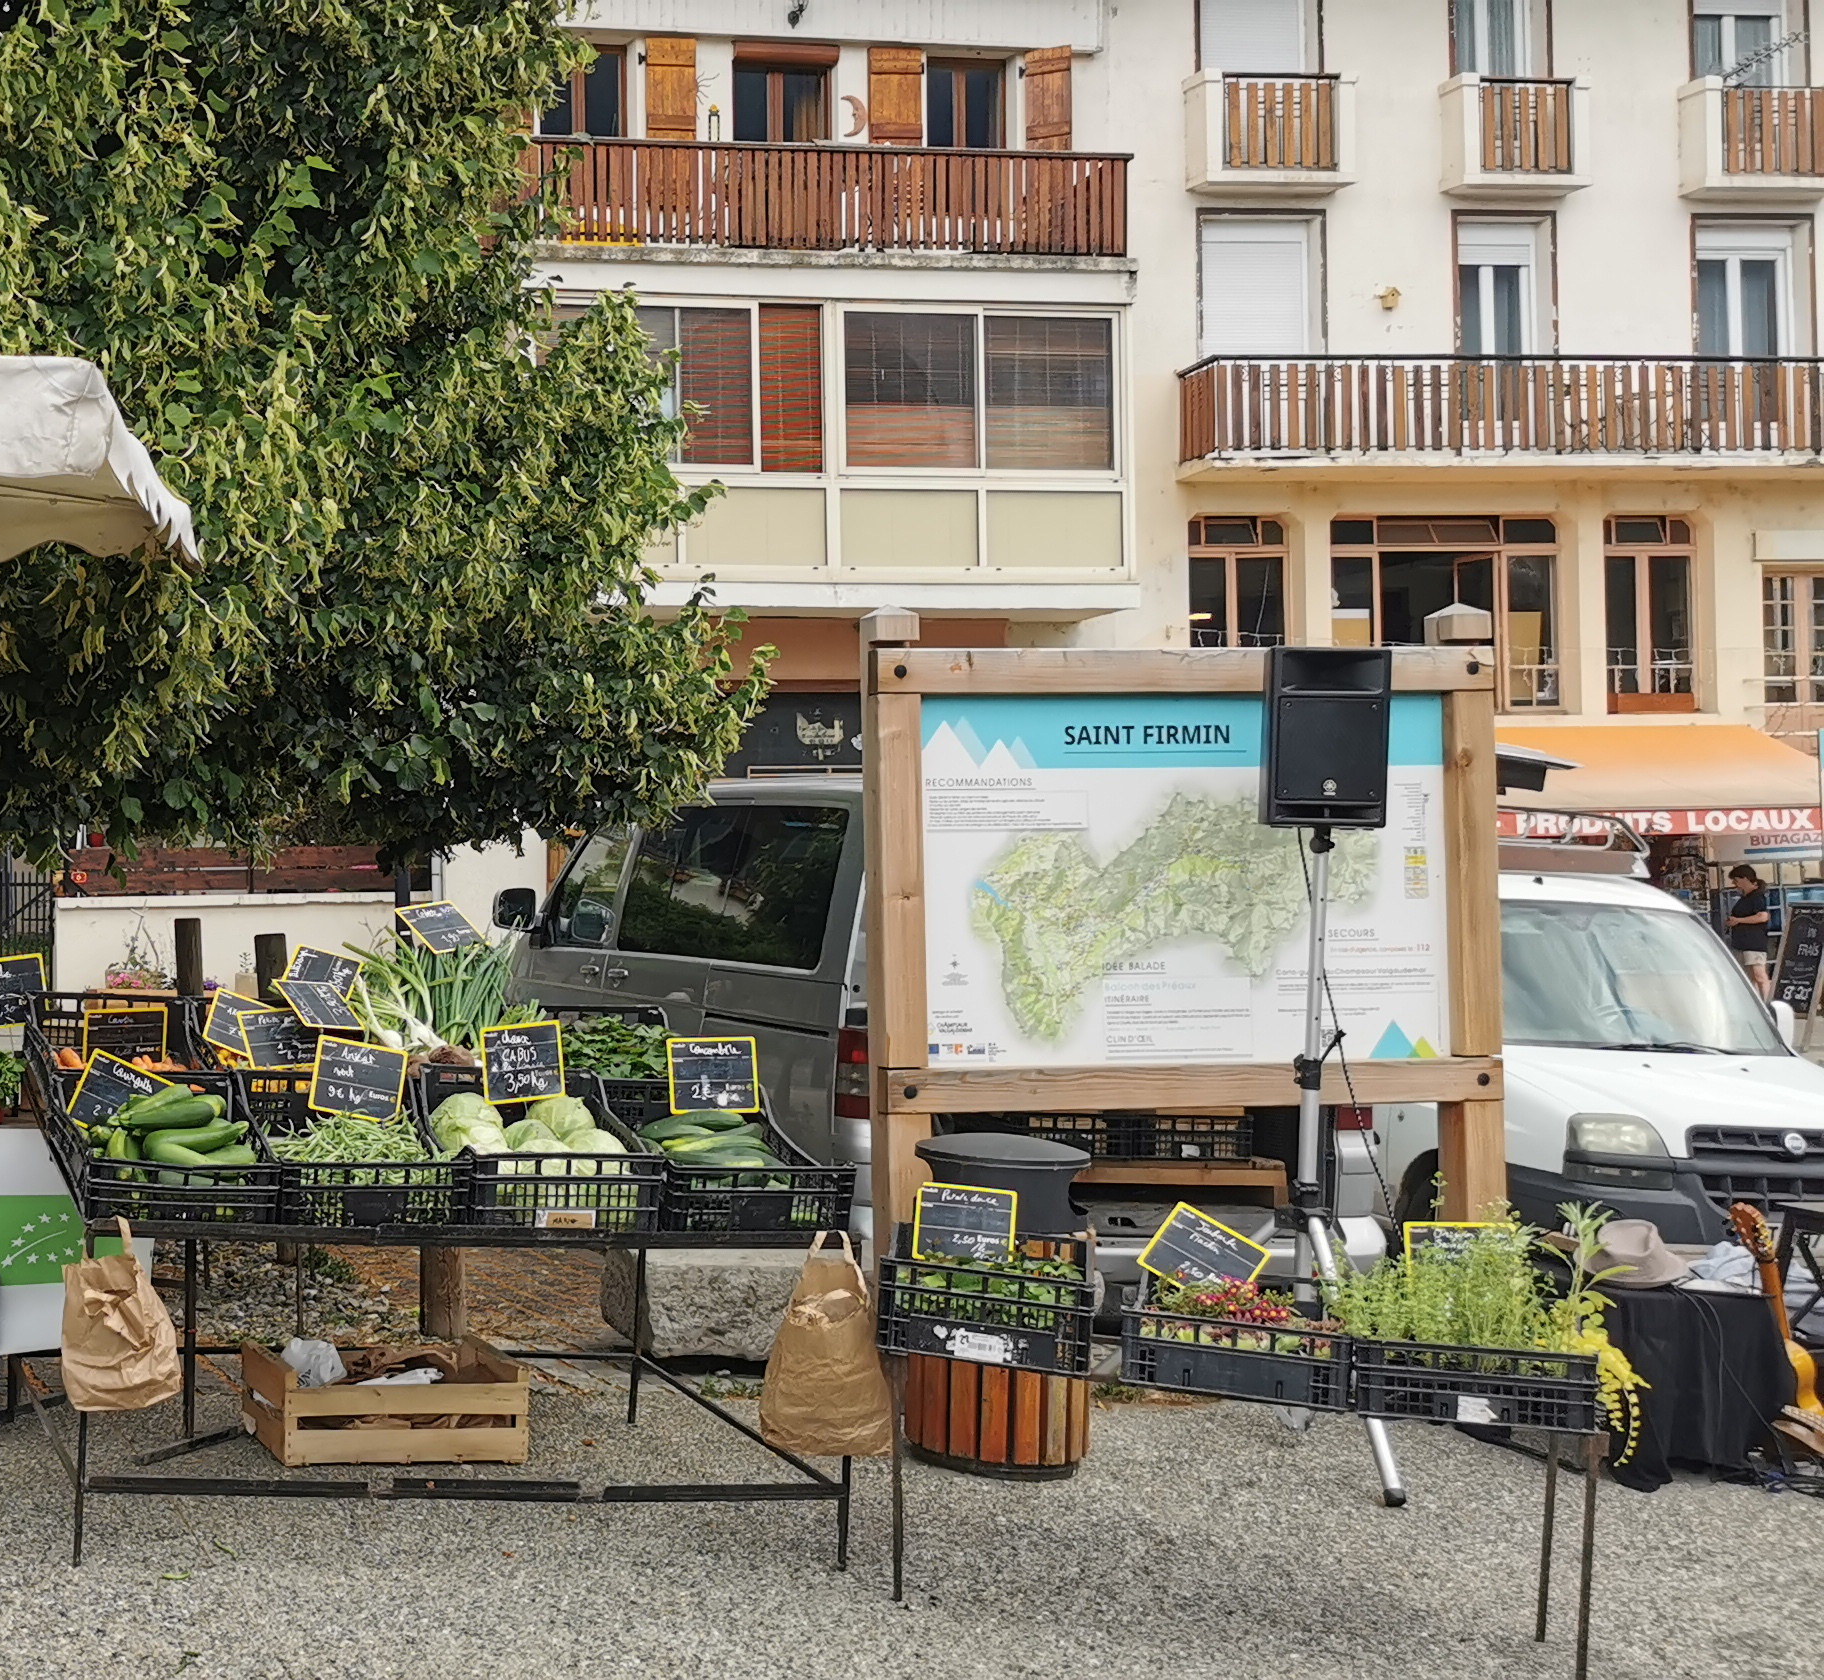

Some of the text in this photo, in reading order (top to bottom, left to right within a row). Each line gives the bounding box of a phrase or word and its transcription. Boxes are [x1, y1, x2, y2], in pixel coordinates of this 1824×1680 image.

[1063, 724, 1231, 746] SAINT FIRMIN
[925, 777, 1033, 788] RECOMMANDATIONS
[1516, 808, 1815, 835] PRODUITS LOCAUX
[1750, 832, 1822, 847] BUTAGAZ
[1327, 928, 1376, 938] SECOURS
[1416, 944, 1431, 952] 112
[1128, 961, 1166, 971] BALADE
[1142, 980, 1161, 991] des
[1104, 994, 1150, 1004] ITINÉRAIRE
[502, 1046, 538, 1063] CABUS
[504, 1072, 531, 1094] 3,50
[368, 1090, 390, 1102] Euros
